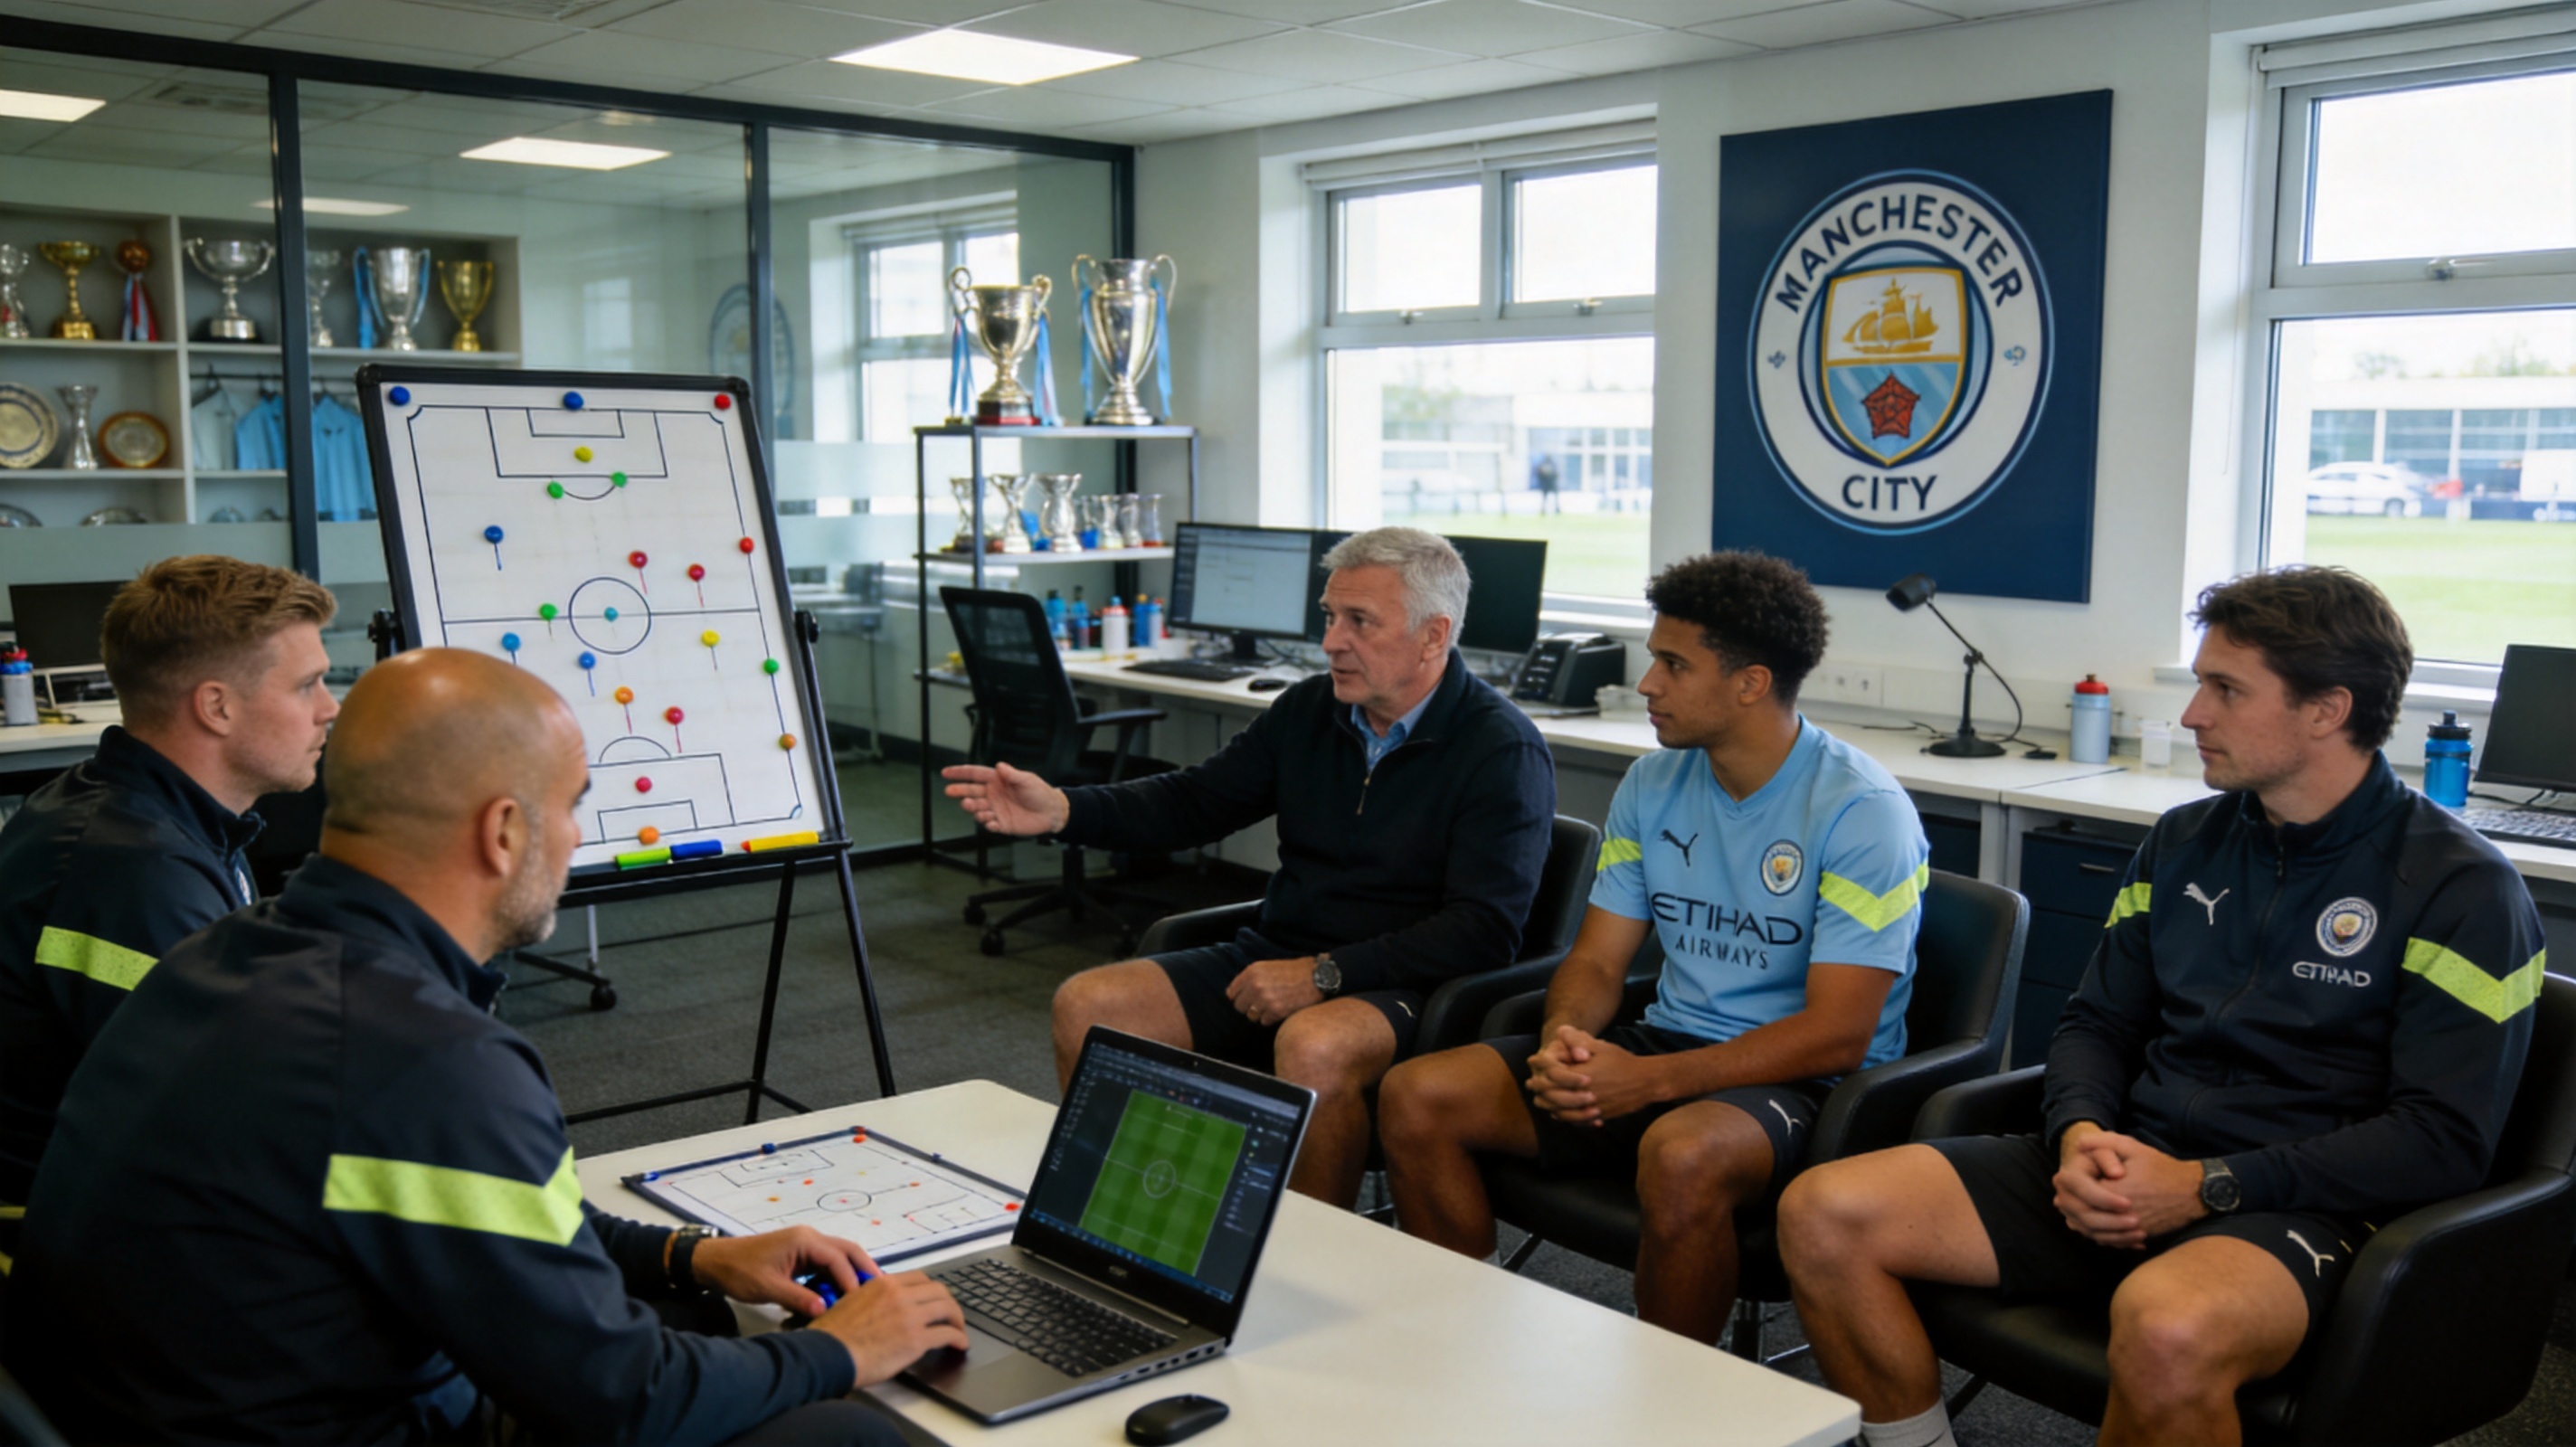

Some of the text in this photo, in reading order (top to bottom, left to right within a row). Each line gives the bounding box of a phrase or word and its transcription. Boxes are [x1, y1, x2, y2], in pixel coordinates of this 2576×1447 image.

[1776, 194, 2023, 313] MANCHESTER
[1842, 475, 1937, 511] CITY
[1652, 893, 1802, 945] ETIHAD
[1675, 934, 1768, 969] AIRWAYS
[2292, 961, 2372, 987] ETIHAD
